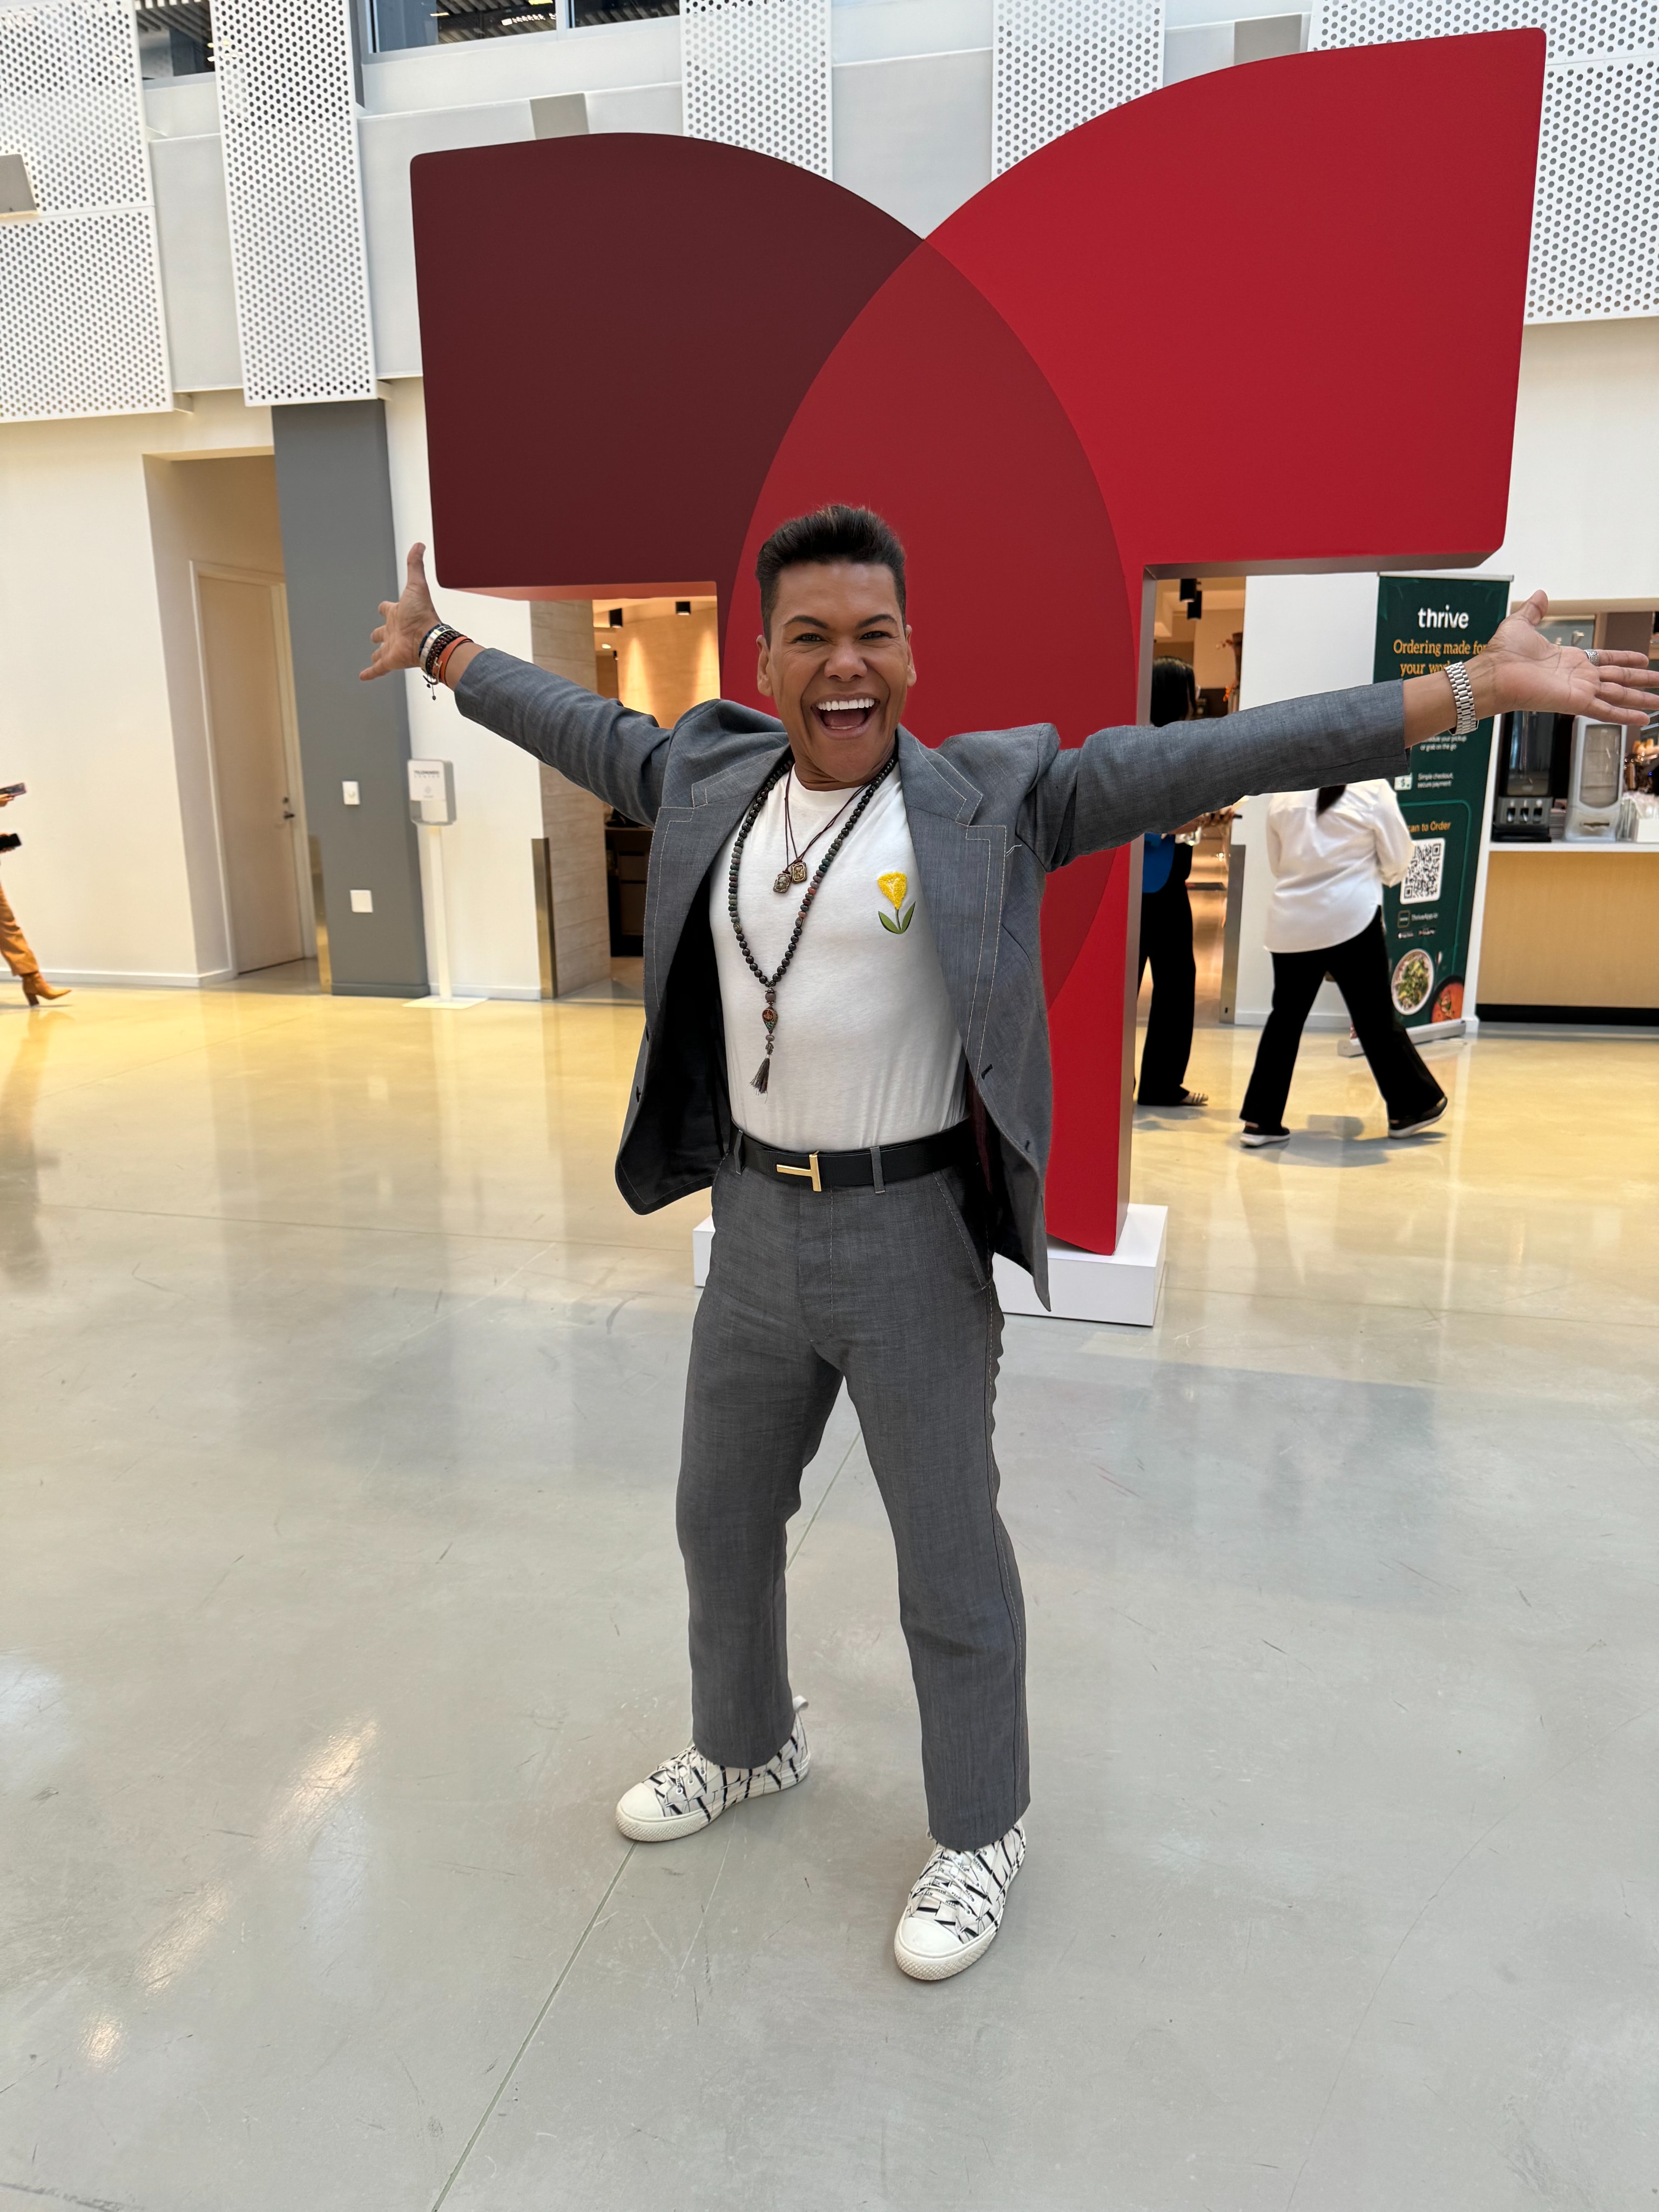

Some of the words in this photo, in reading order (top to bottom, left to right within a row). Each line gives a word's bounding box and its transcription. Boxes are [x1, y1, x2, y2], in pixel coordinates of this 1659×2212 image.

[1418, 604, 1469, 629] thrive
[1393, 639, 1442, 657] Ordering
[1443, 640, 1471, 655] made
[1400, 663, 1426, 677] your
[1421, 824, 1428, 832] to
[1430, 820, 1451, 831] Order
